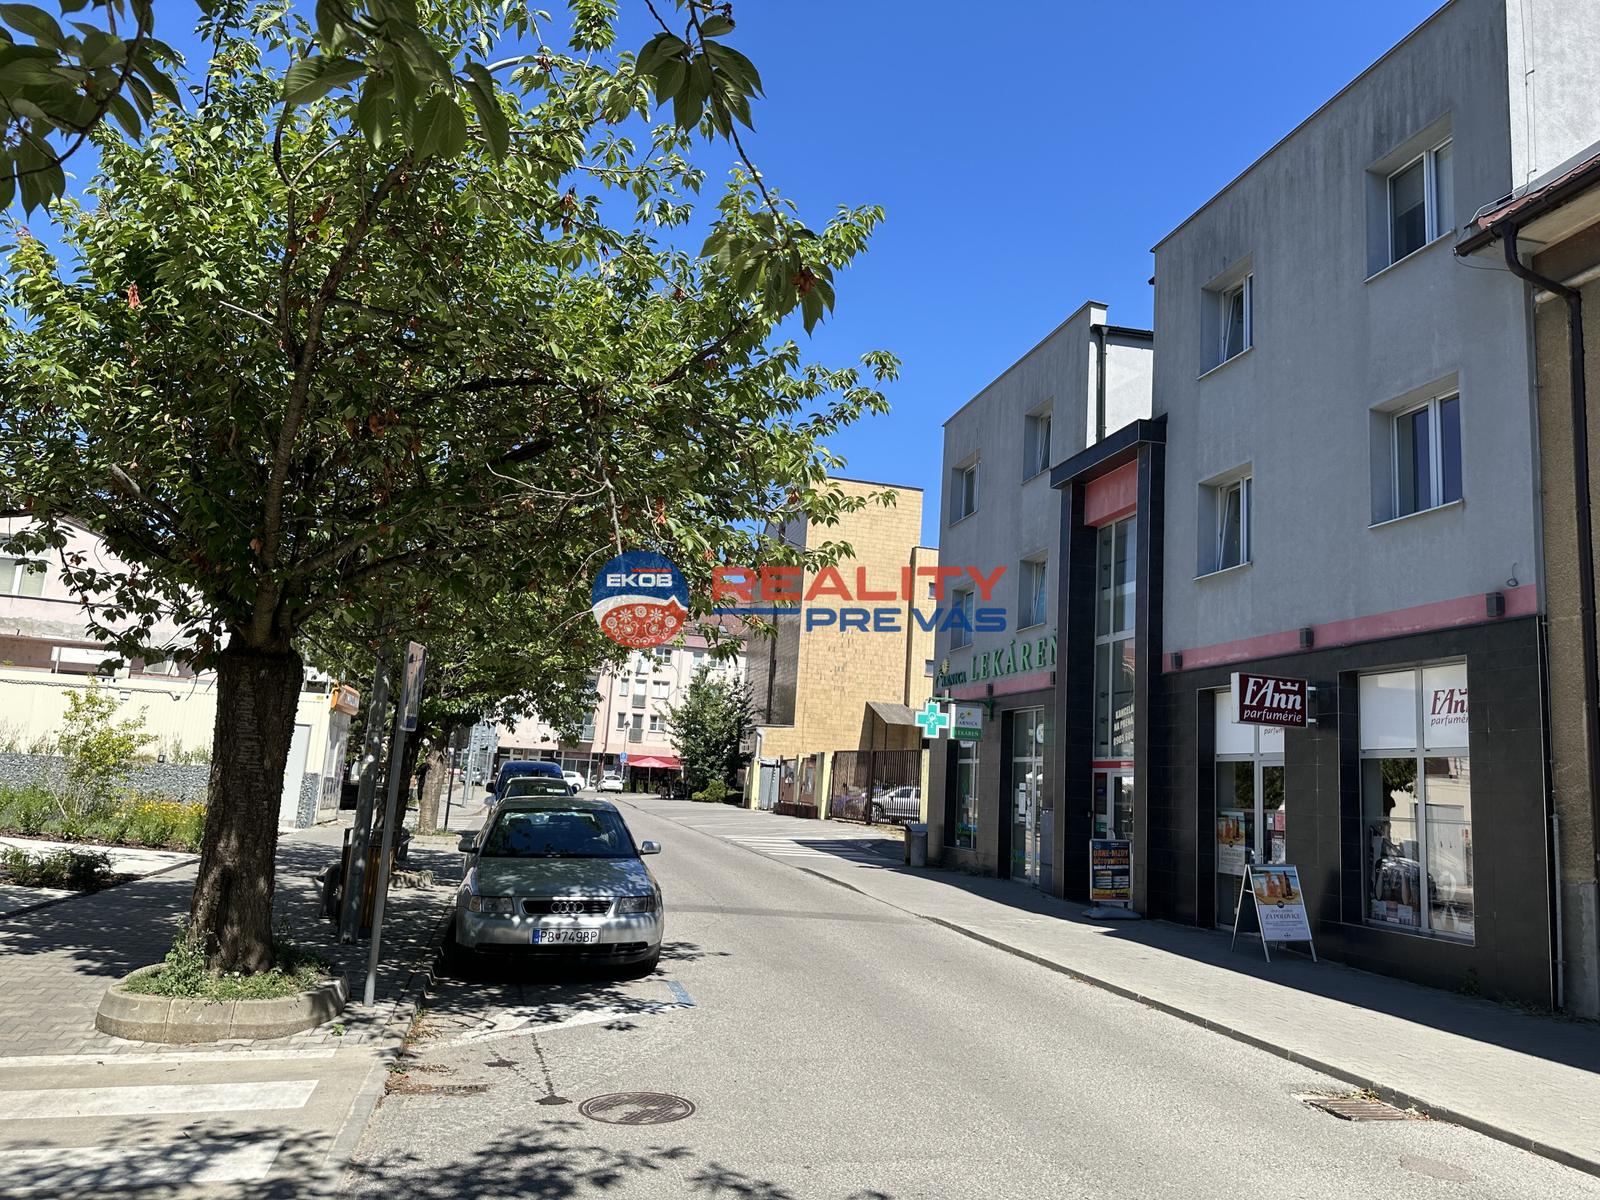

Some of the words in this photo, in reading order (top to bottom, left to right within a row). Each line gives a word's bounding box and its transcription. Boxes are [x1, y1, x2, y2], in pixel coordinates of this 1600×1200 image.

[1243, 677, 1302, 710] FAnn
[1431, 688, 1468, 715] FAn
[1243, 709, 1302, 722] parfumérie
[540, 931, 555, 943] PB
[561, 931, 598, 943] 749BP
